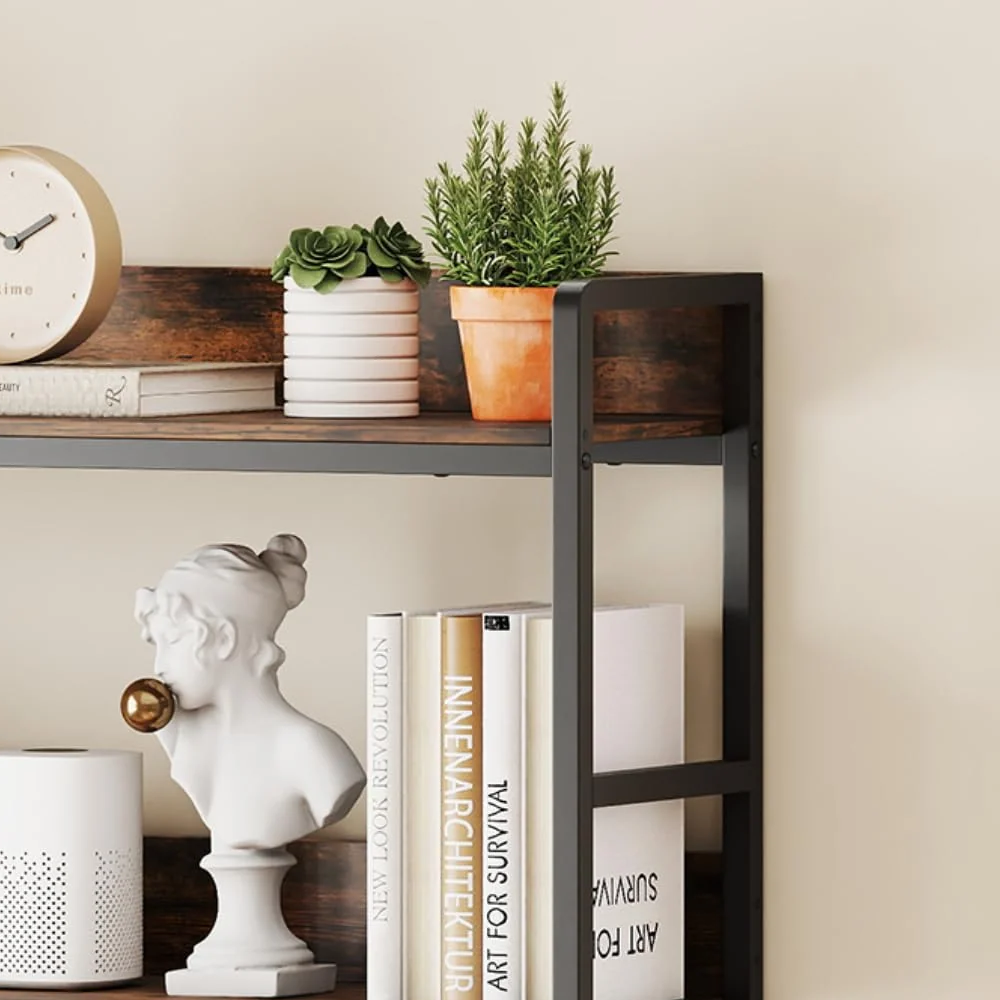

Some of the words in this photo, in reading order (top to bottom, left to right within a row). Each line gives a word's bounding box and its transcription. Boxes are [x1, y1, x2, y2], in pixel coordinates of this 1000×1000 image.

[372, 637, 389, 788] REVOLUTION
[372, 797, 389, 862] LOOK
[443, 675, 474, 993] INNENARCHITEKTUR
[486, 780, 509, 885] SURVIVAL
[372, 869, 389, 922] NEW
[486, 893, 508, 939] FOR
[592, 872, 658, 908] SURVIVA
[627, 922, 659, 955] ART
[486, 949, 508, 992] ART
